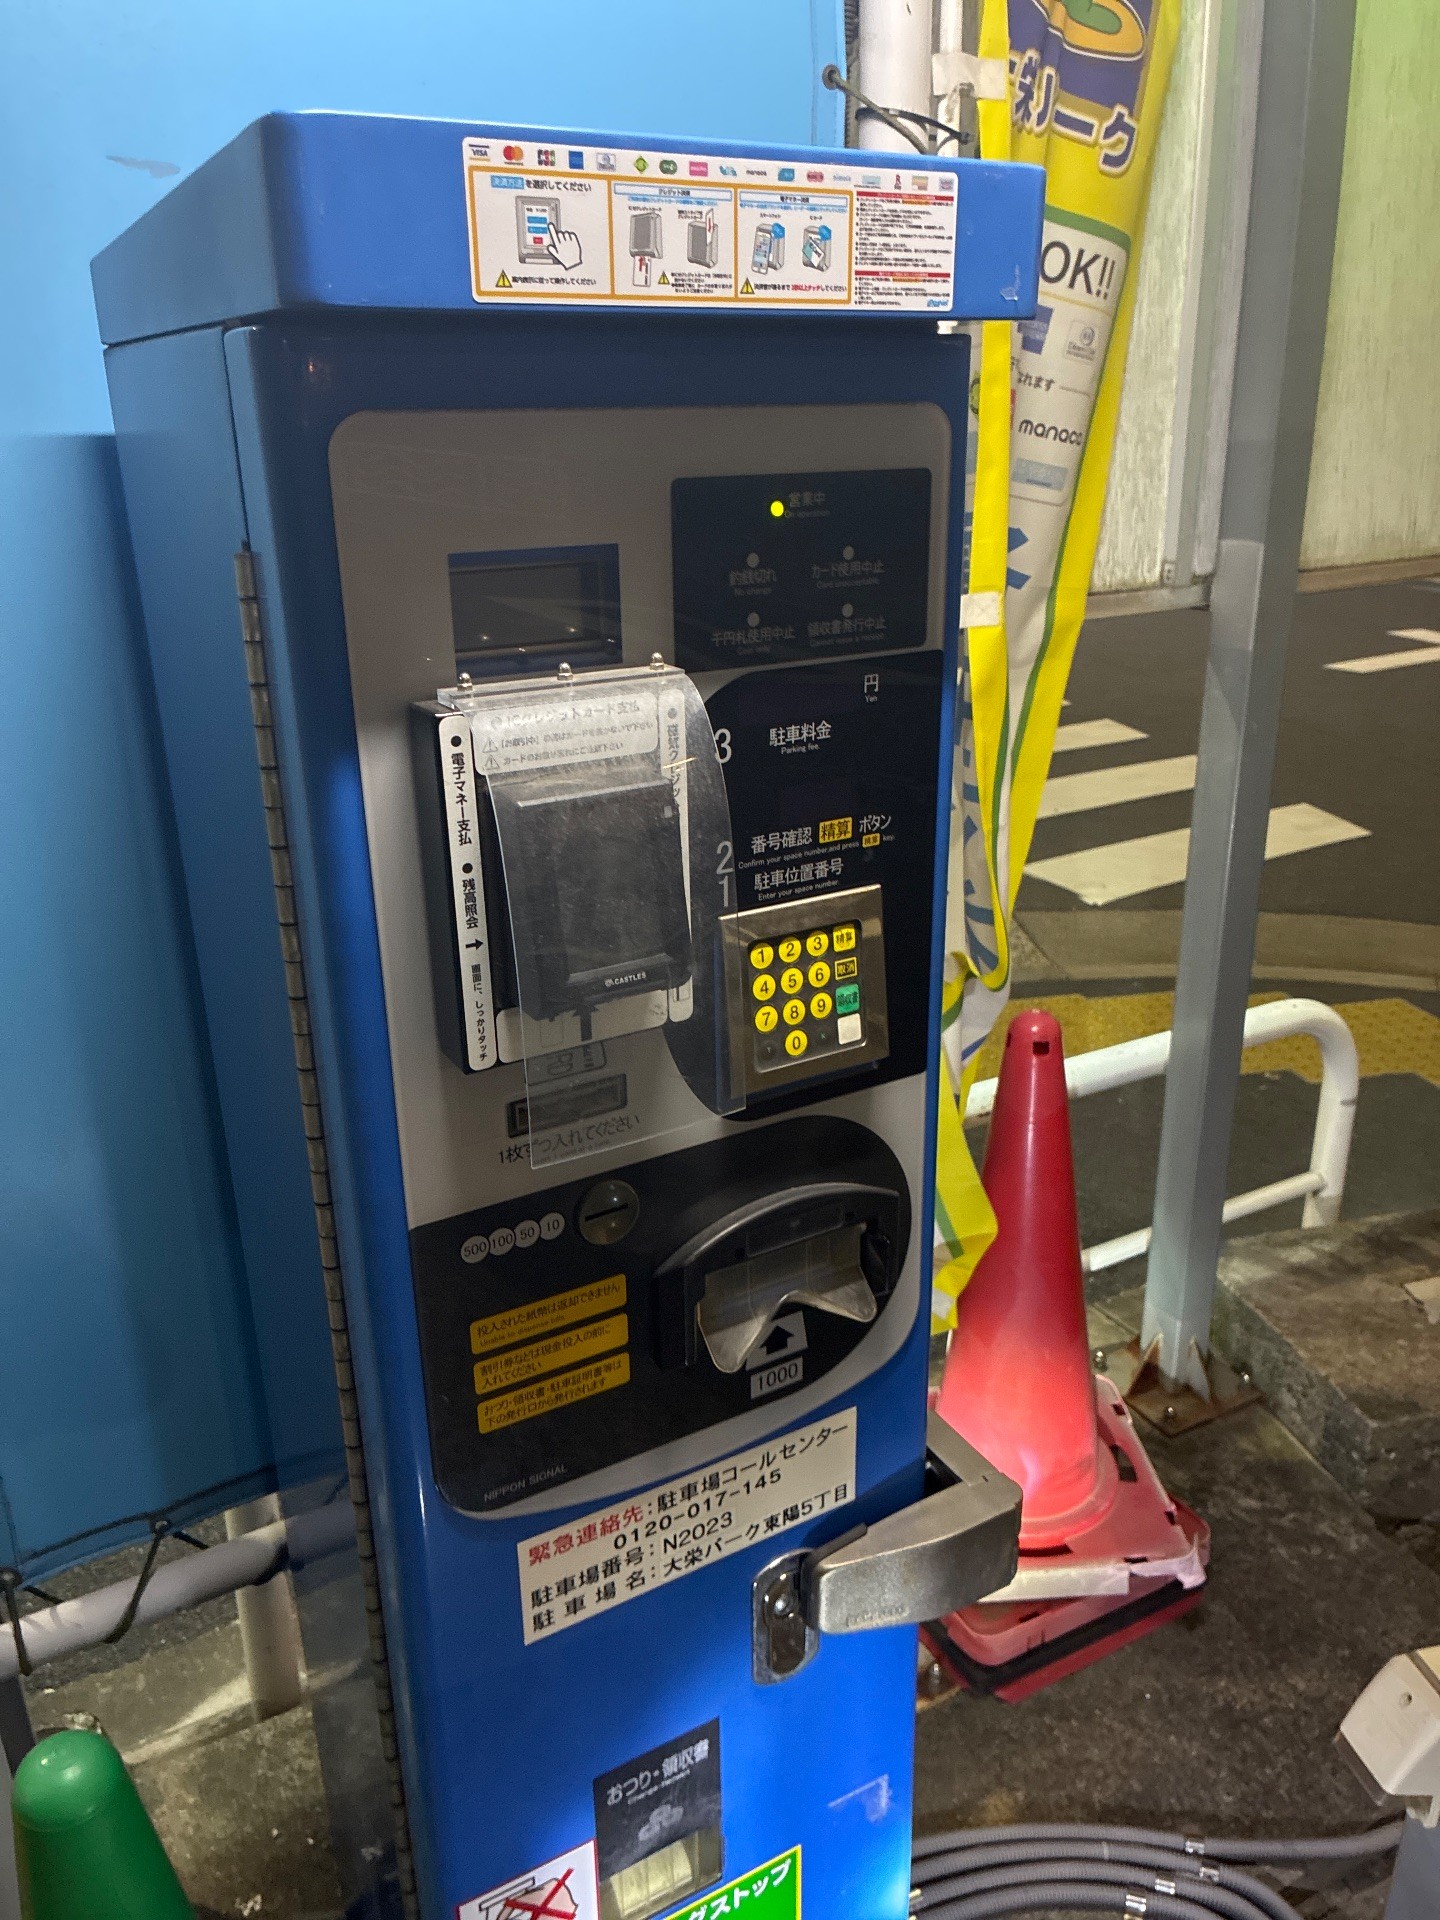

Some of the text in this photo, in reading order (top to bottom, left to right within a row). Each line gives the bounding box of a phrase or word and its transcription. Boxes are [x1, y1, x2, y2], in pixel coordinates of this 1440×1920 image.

[472, 148, 488, 157] VISA
[1041, 241, 1115, 300] OK!!
[864, 673, 879, 694] 円
[865, 693, 878, 703] Yen
[715, 727, 732, 764] 3
[769, 720, 832, 747] 駐車料金
[780, 746, 806, 755] Parking
[451, 752, 473, 847] 電子マネー支払
[462, 878, 479, 930] 残高照会
[751, 827, 813, 855] 番号確認
[820, 819, 852, 842] 精算
[716, 840, 733, 876] 2
[738, 858, 765, 869] Confirm
[766, 855, 782, 864] your
[783, 851, 803, 862] space
[754, 857, 844, 891] 駐車位置番号
[718, 875, 730, 908] 1
[758, 891, 776, 901] Enter
[778, 889, 793, 898] your
[794, 885, 813, 896] space
[758, 948, 765, 963] 1
[786, 942, 795, 957] 2
[813, 937, 822, 951] 3
[614, 971, 647, 985] CASTLES
[760, 961, 855, 994] 4 5 6 取消
[762, 1012, 770, 1026] 7
[790, 1005, 799, 1019] 8
[817, 999, 826, 1013] 9
[792, 1036, 801, 1050] 0
[463, 1219, 560, 1258] 500 100 50 10
[481, 1361, 541, 1390] 入れてください
[757, 1362, 798, 1391] 1000
[483, 1463, 568, 1502] NIPPON SIGNAL
[614, 1468, 782, 1550] 0120-017-145
[606, 1738, 710, 1806] おつり・領収書
